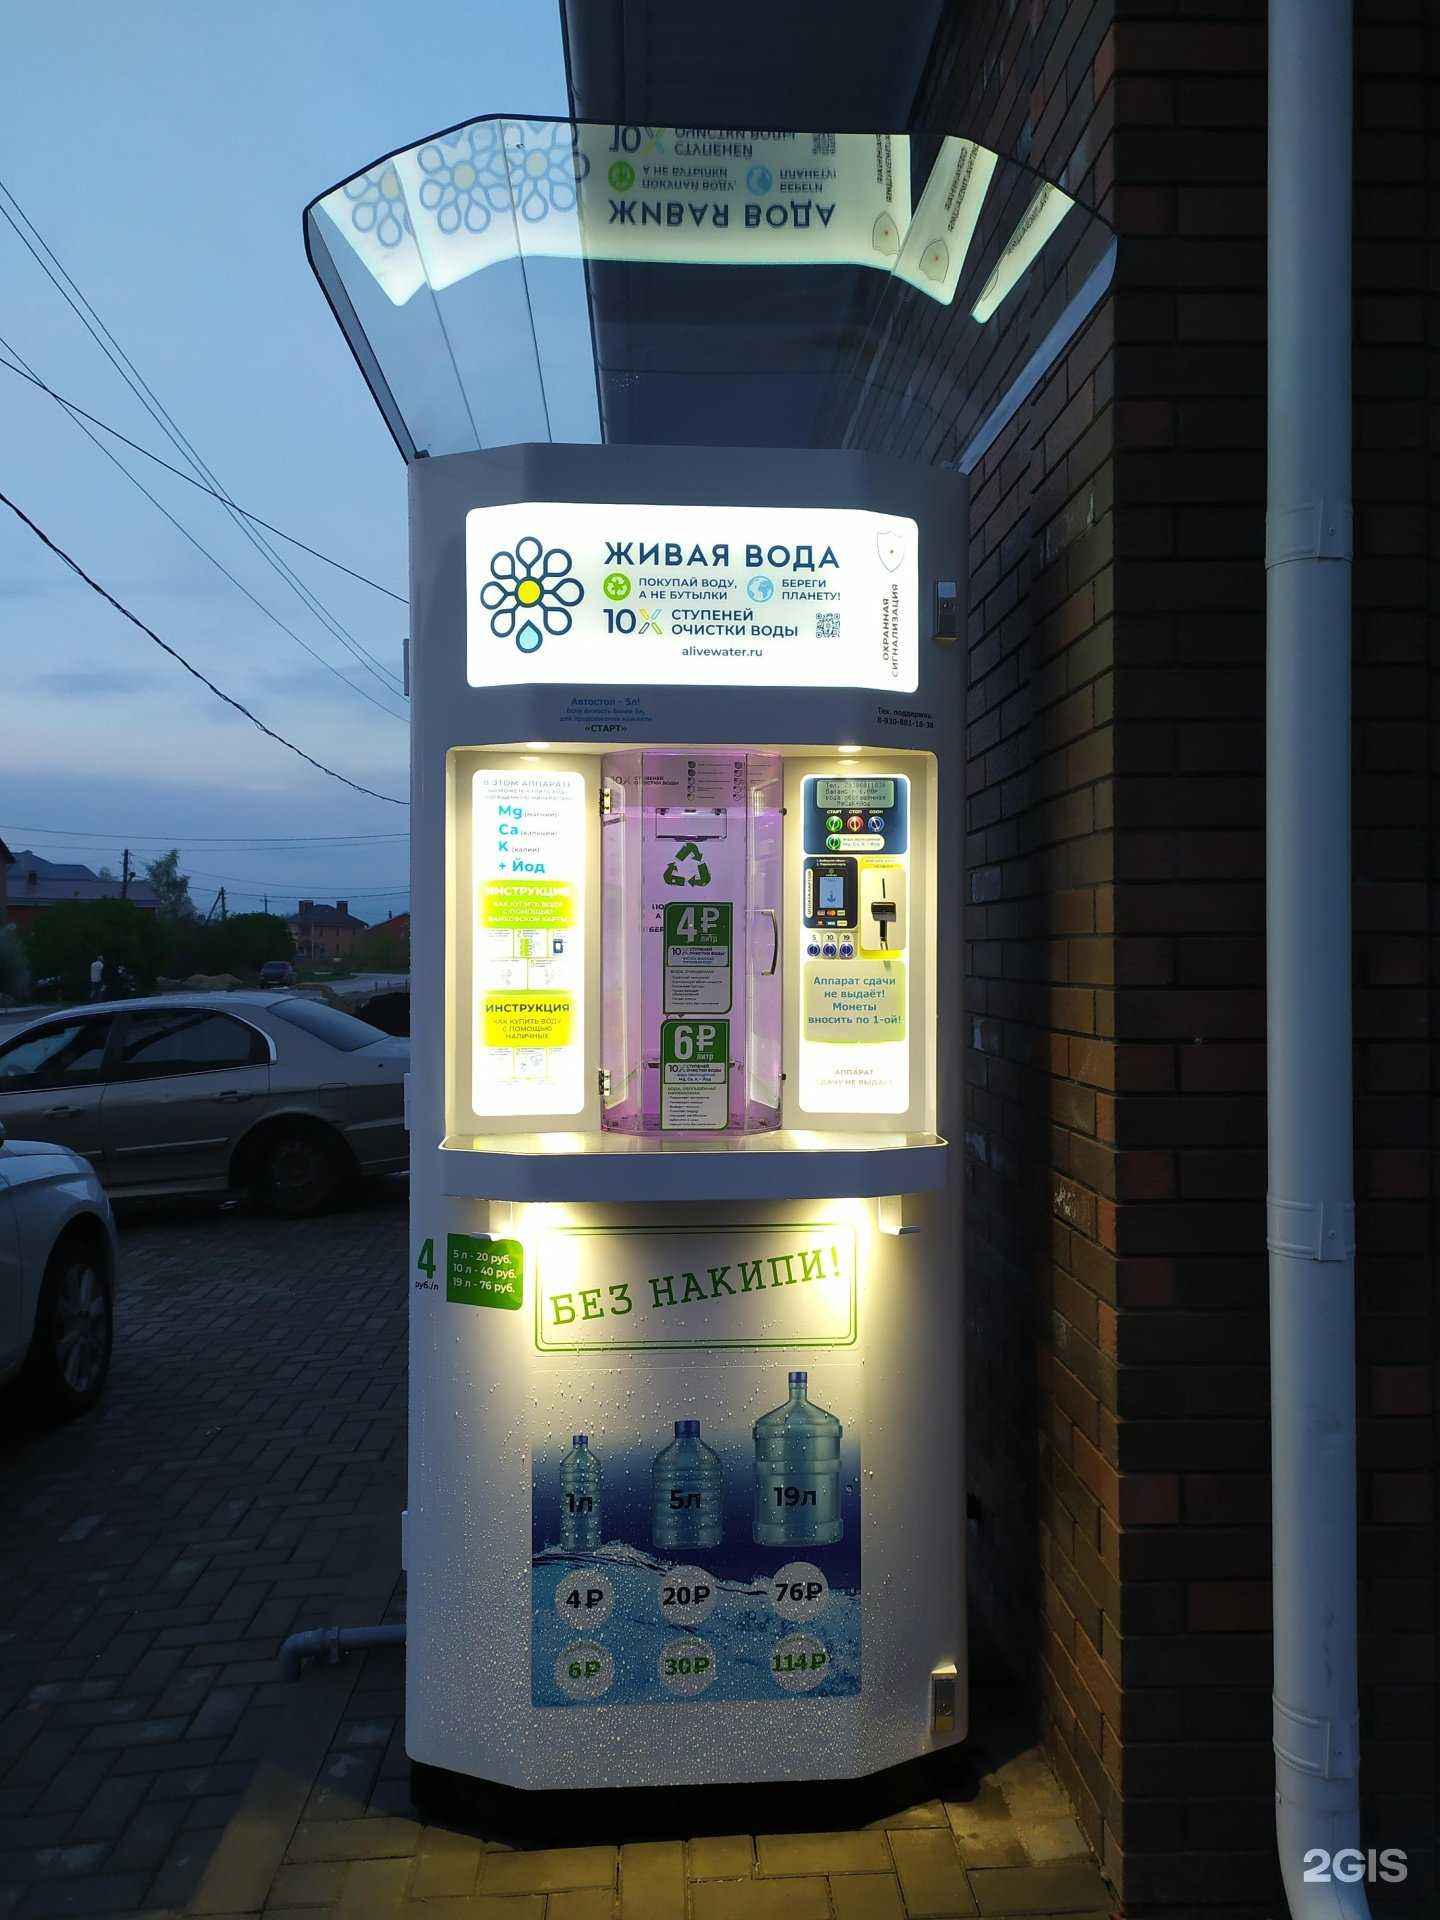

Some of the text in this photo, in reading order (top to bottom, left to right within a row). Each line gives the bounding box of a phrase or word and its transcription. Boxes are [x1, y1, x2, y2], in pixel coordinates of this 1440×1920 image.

[604, 541, 840, 572] ЖИВАЯ ВОДА
[639, 577, 737, 590] ПОКУПАЙ ВОДУ,
[782, 579, 827, 588] БЕРЕГИ
[639, 591, 728, 601] А НЕ БУТЫЛКИ
[782, 592, 841, 601] ПЛАНЕТУ!
[671, 608, 754, 622] СТУПЕНЕЙ
[671, 624, 799, 639] ОЧИСТКИ ВОДЫ
[882, 598, 890, 661] ОХРАННАЯ
[891, 584, 899, 678] СИГНАЛИЗАЦИЯ
[681, 646, 763, 658] alivewater.ru
[584, 724, 627, 733] «СТАРТ»
[498, 805, 522, 819] Mg
[498, 824, 519, 836] Ca
[512, 858, 545, 873] Йод
[814, 976, 896, 986] Аппарат сдачи
[841, 989, 885, 999] выдаёт!
[486, 1004, 570, 1013] ИНСТРУКЦИЯ
[832, 1002, 877, 1011] Монеты
[418, 1239, 436, 1278] 4
[453, 1250, 459, 1258] 5
[476, 1253, 488, 1261] 20
[491, 1255, 512, 1265] руб.
[453, 1264, 463, 1272] 10
[481, 1268, 494, 1276] 40
[496, 1270, 517, 1280] руб.
[453, 1278, 463, 1287] 19
[480, 1281, 492, 1290] 76
[494, 1283, 515, 1293] руб.
[549, 1246, 841, 1325] БЕЗ НАКИПИ!
[566, 1487, 817, 1513] 1л 5л 19л
